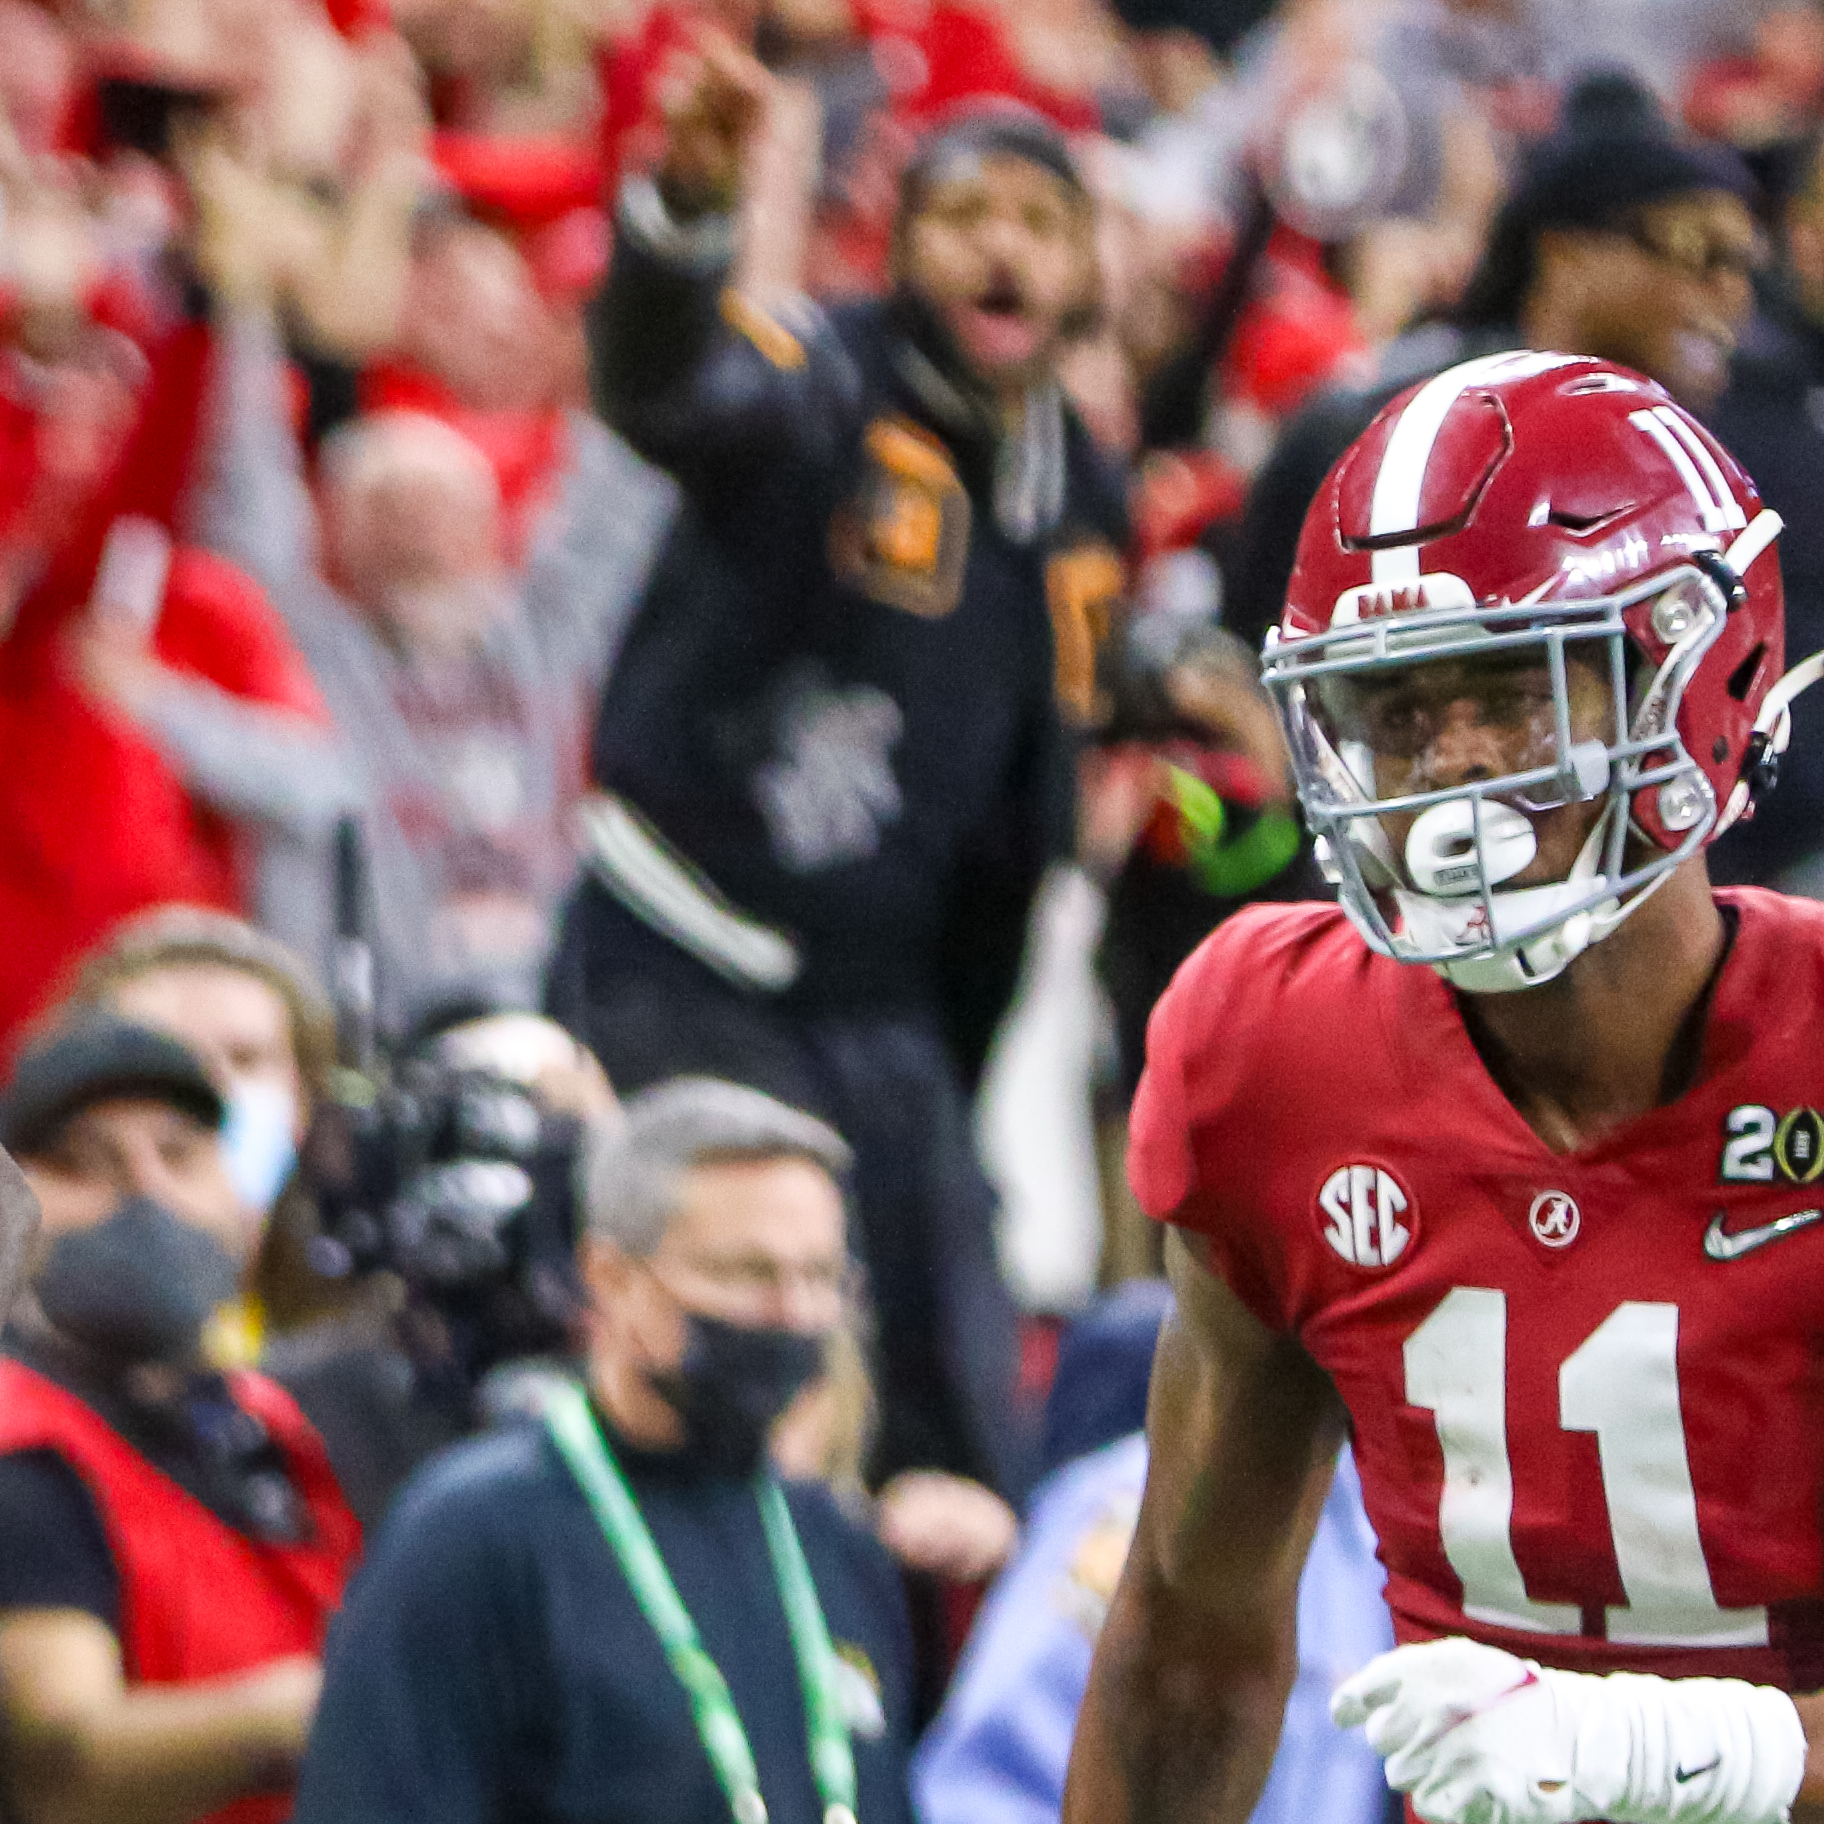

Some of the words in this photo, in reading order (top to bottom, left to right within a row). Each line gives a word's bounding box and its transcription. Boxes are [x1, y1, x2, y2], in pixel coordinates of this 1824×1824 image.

[1627, 405, 1748, 533] 11
[1318, 1164, 1411, 1266] SEC
[1402, 1286, 1770, 1648] 11
